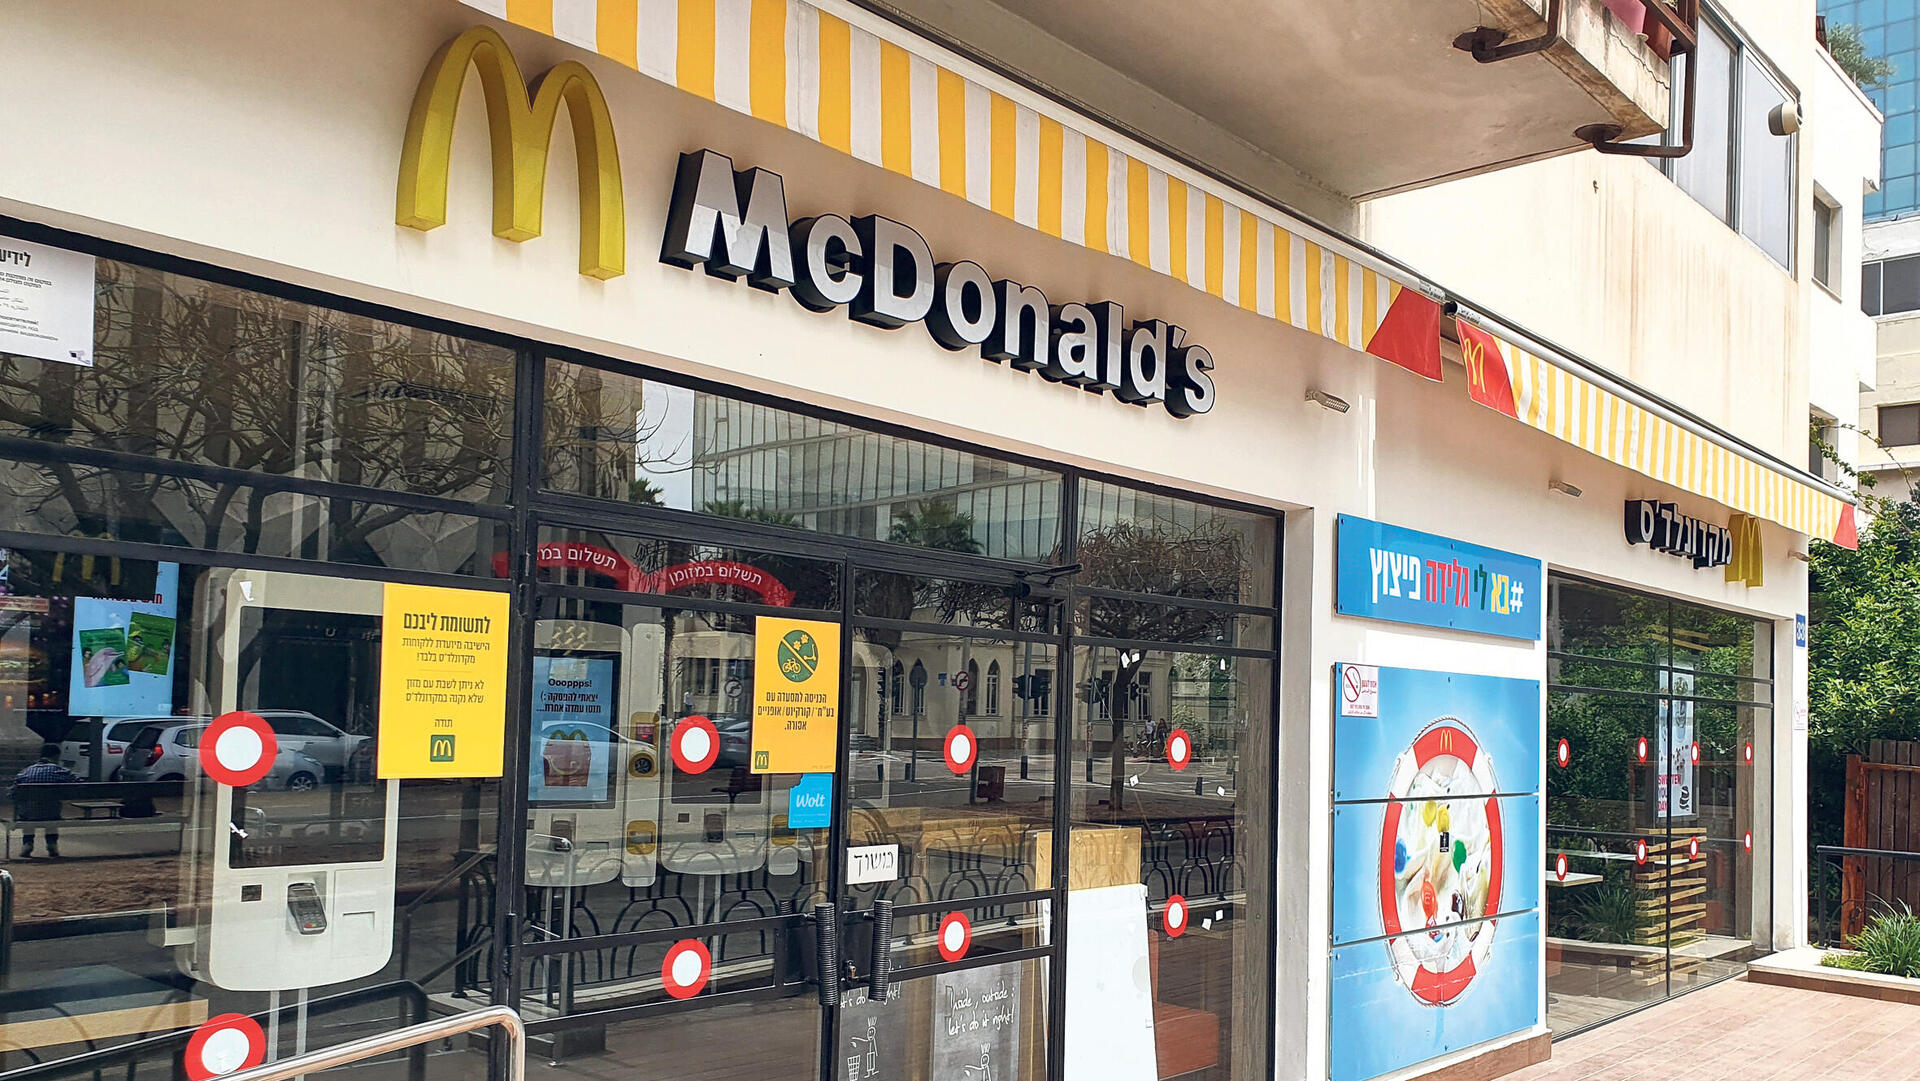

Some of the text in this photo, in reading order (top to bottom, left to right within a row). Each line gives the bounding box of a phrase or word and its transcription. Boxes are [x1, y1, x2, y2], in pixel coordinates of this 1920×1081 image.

[659, 149, 1215, 419] McDonald's
[568, 547, 617, 570] תשלום
[669, 566, 762, 586] תשלום במזומן
[1369, 547, 1421, 604] פיצוץ
[1426, 558, 1470, 609] גלידה
[1474, 564, 1487, 611] לי
[403, 612, 491, 634] לתשומת ליבכם
[402, 637, 490, 651] הישיבה מיועדת ללקוחות
[416, 651, 437, 662] בלבד!
[406, 678, 485, 691] לא ניתן לשבת עם מזון
[449, 693, 466, 705] נקנה
[468, 692, 484, 704] שלא
[766, 691, 827, 703] הכניסה למסעדה עם
[434, 718, 453, 728] תודה
[784, 720, 807, 731] אסורה.
[796, 792, 825, 808] Wolt
[969, 1010, 980, 1031] do
